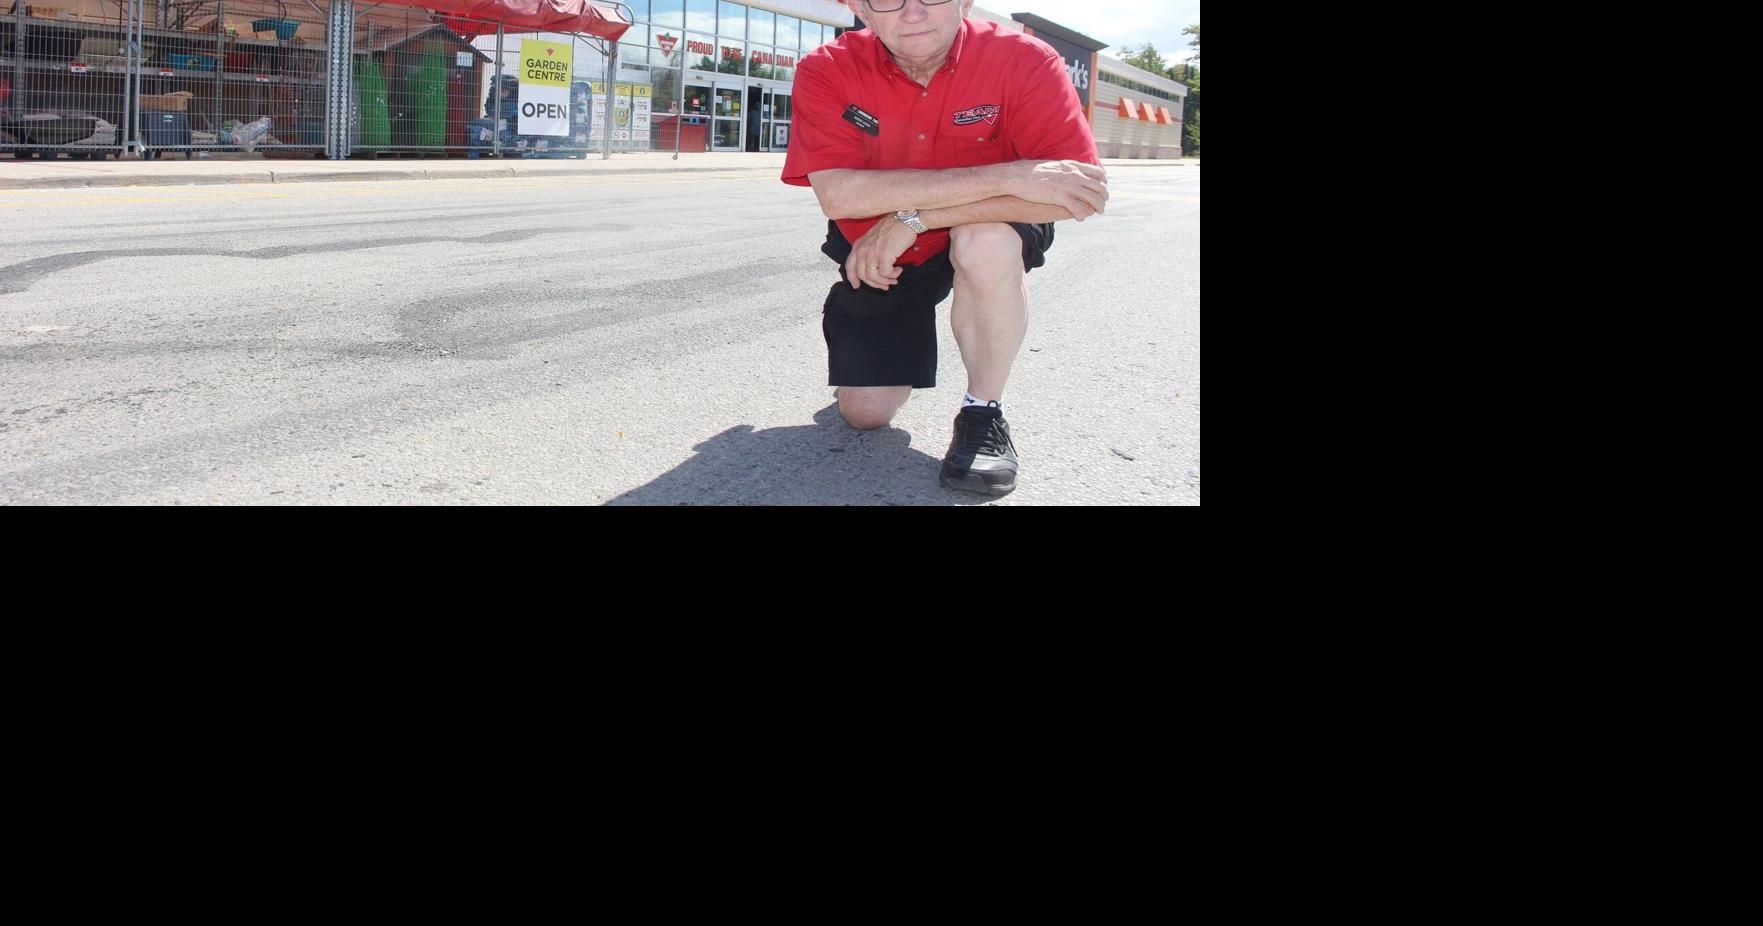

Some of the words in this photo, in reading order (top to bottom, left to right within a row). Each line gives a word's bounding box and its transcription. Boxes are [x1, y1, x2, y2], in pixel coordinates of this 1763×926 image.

[687, 40, 714, 56] PROUD
[751, 50, 794, 68] CANADIAN
[526, 58, 568, 71] GARDEN
[527, 69, 566, 82] CENTRE
[522, 102, 567, 119] OPEN
[953, 105, 1000, 119] TEAM
